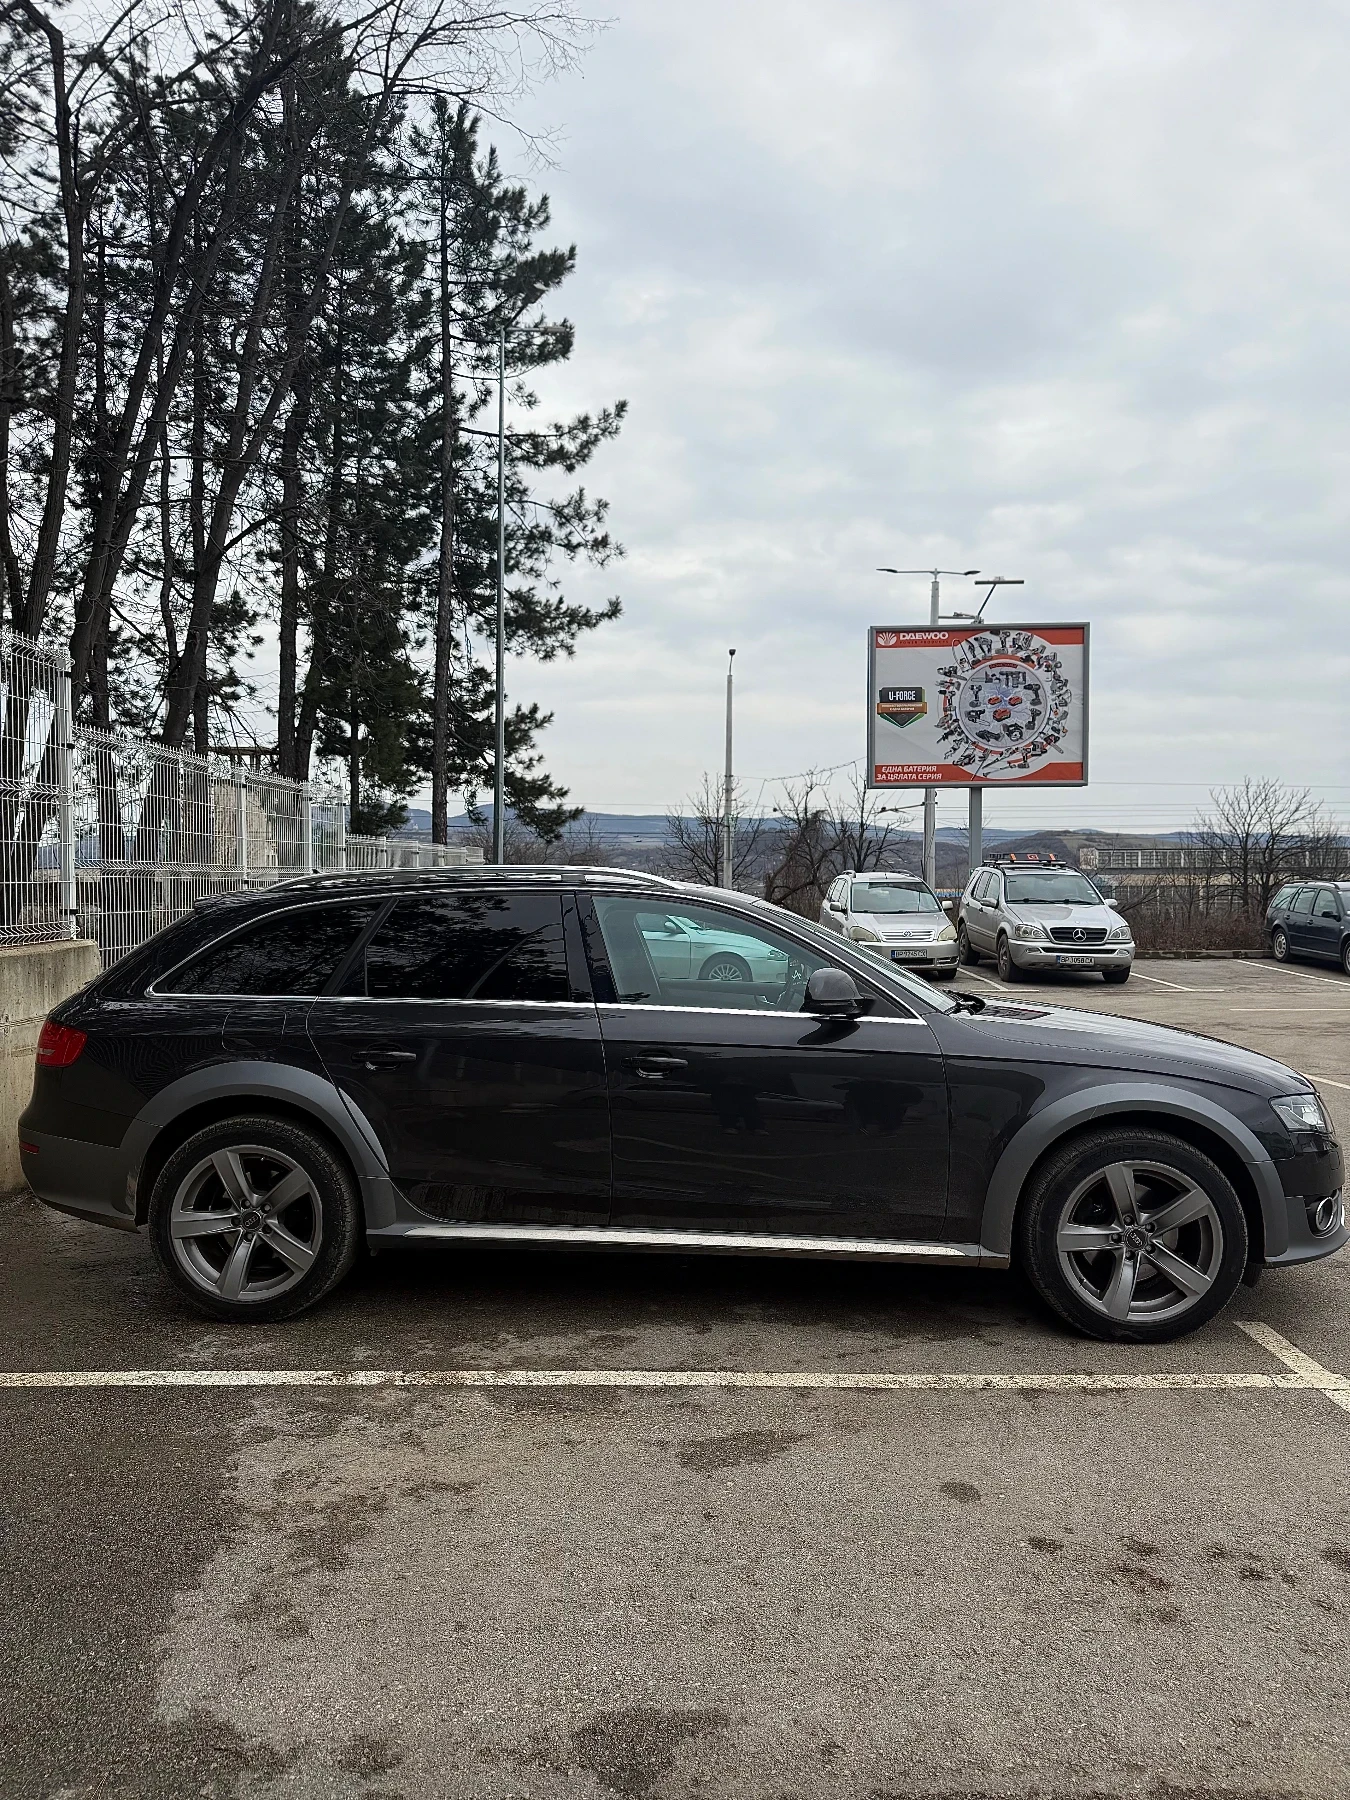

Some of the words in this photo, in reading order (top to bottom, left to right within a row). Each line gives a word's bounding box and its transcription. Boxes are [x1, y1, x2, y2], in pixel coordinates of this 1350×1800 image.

[899, 631, 949, 640] DAEWOO
[888, 690, 916, 701] U-FORCE
[887, 773, 917, 781] ЦЯЛАТА
